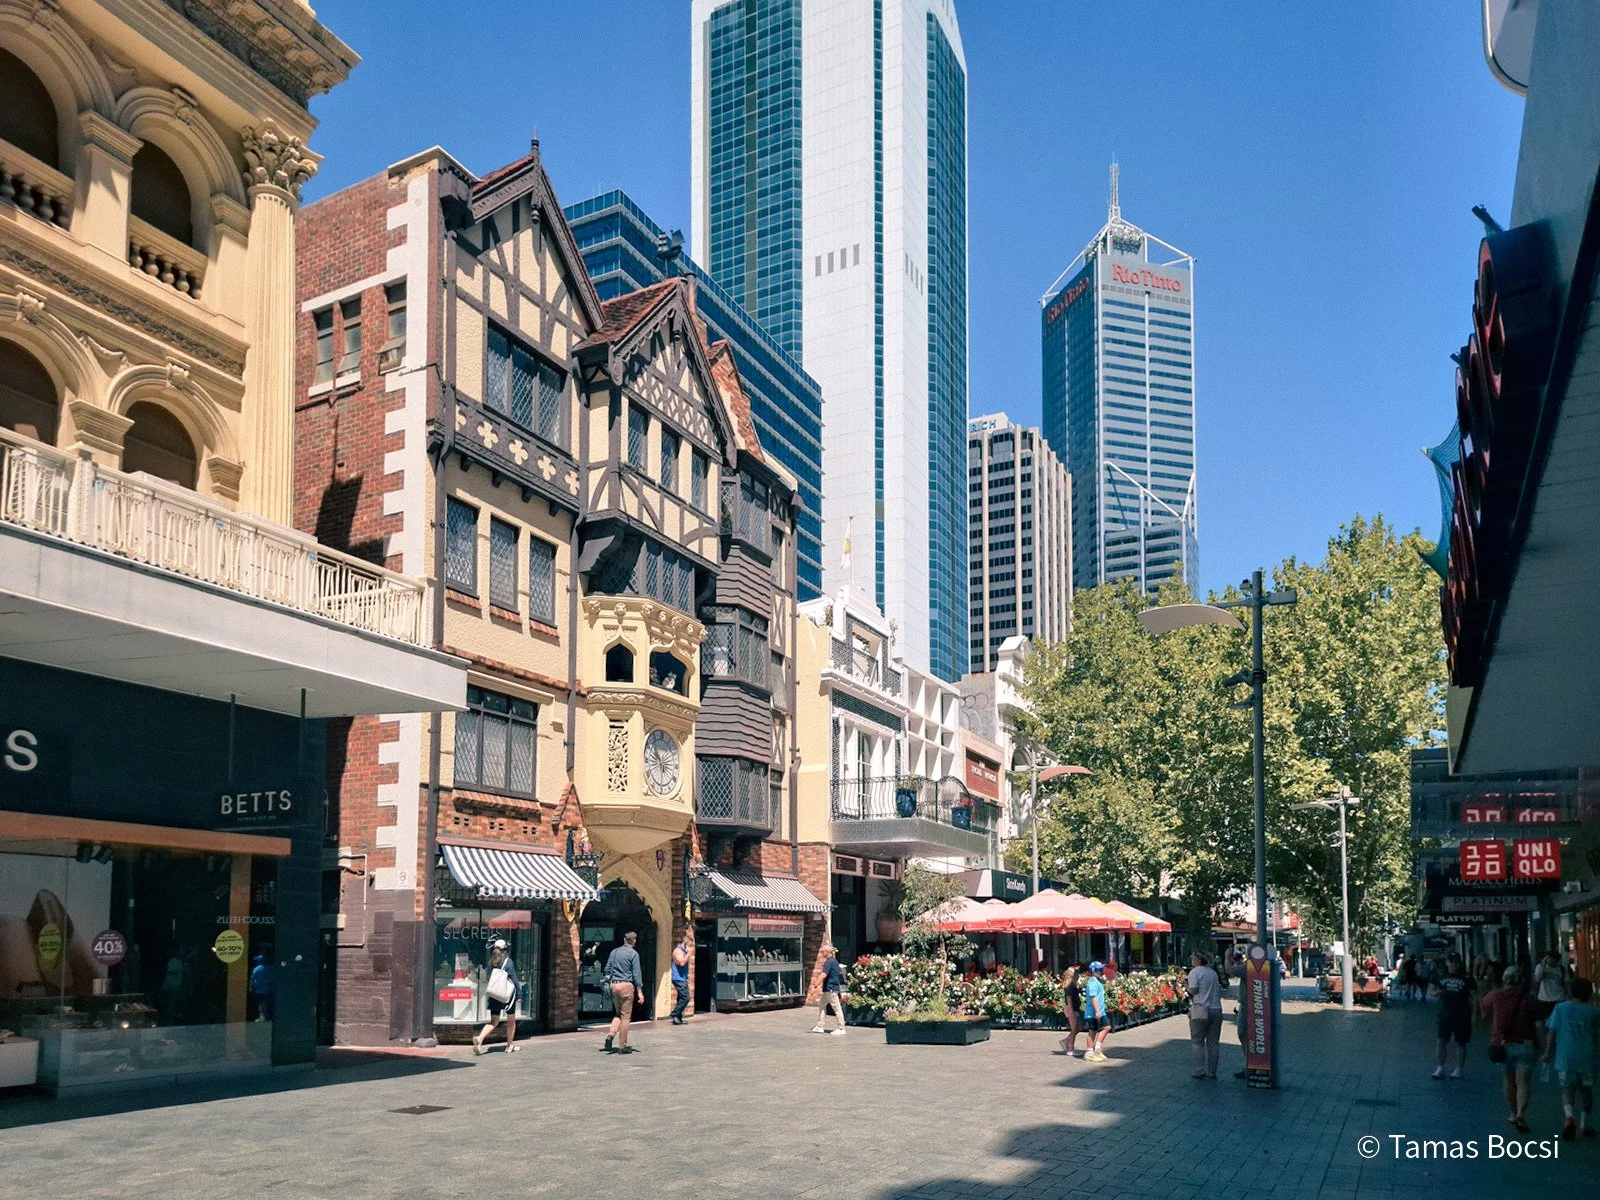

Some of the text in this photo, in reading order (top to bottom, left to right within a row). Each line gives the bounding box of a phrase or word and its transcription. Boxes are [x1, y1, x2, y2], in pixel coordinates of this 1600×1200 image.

[1112, 263, 1184, 292] Rio Tinto
[221, 789, 292, 815] BETTS
[1518, 842, 1552, 857] UNI
[1519, 858, 1556, 876] QLO
[1253, 979, 1266, 1054] FRINGE WORLD
